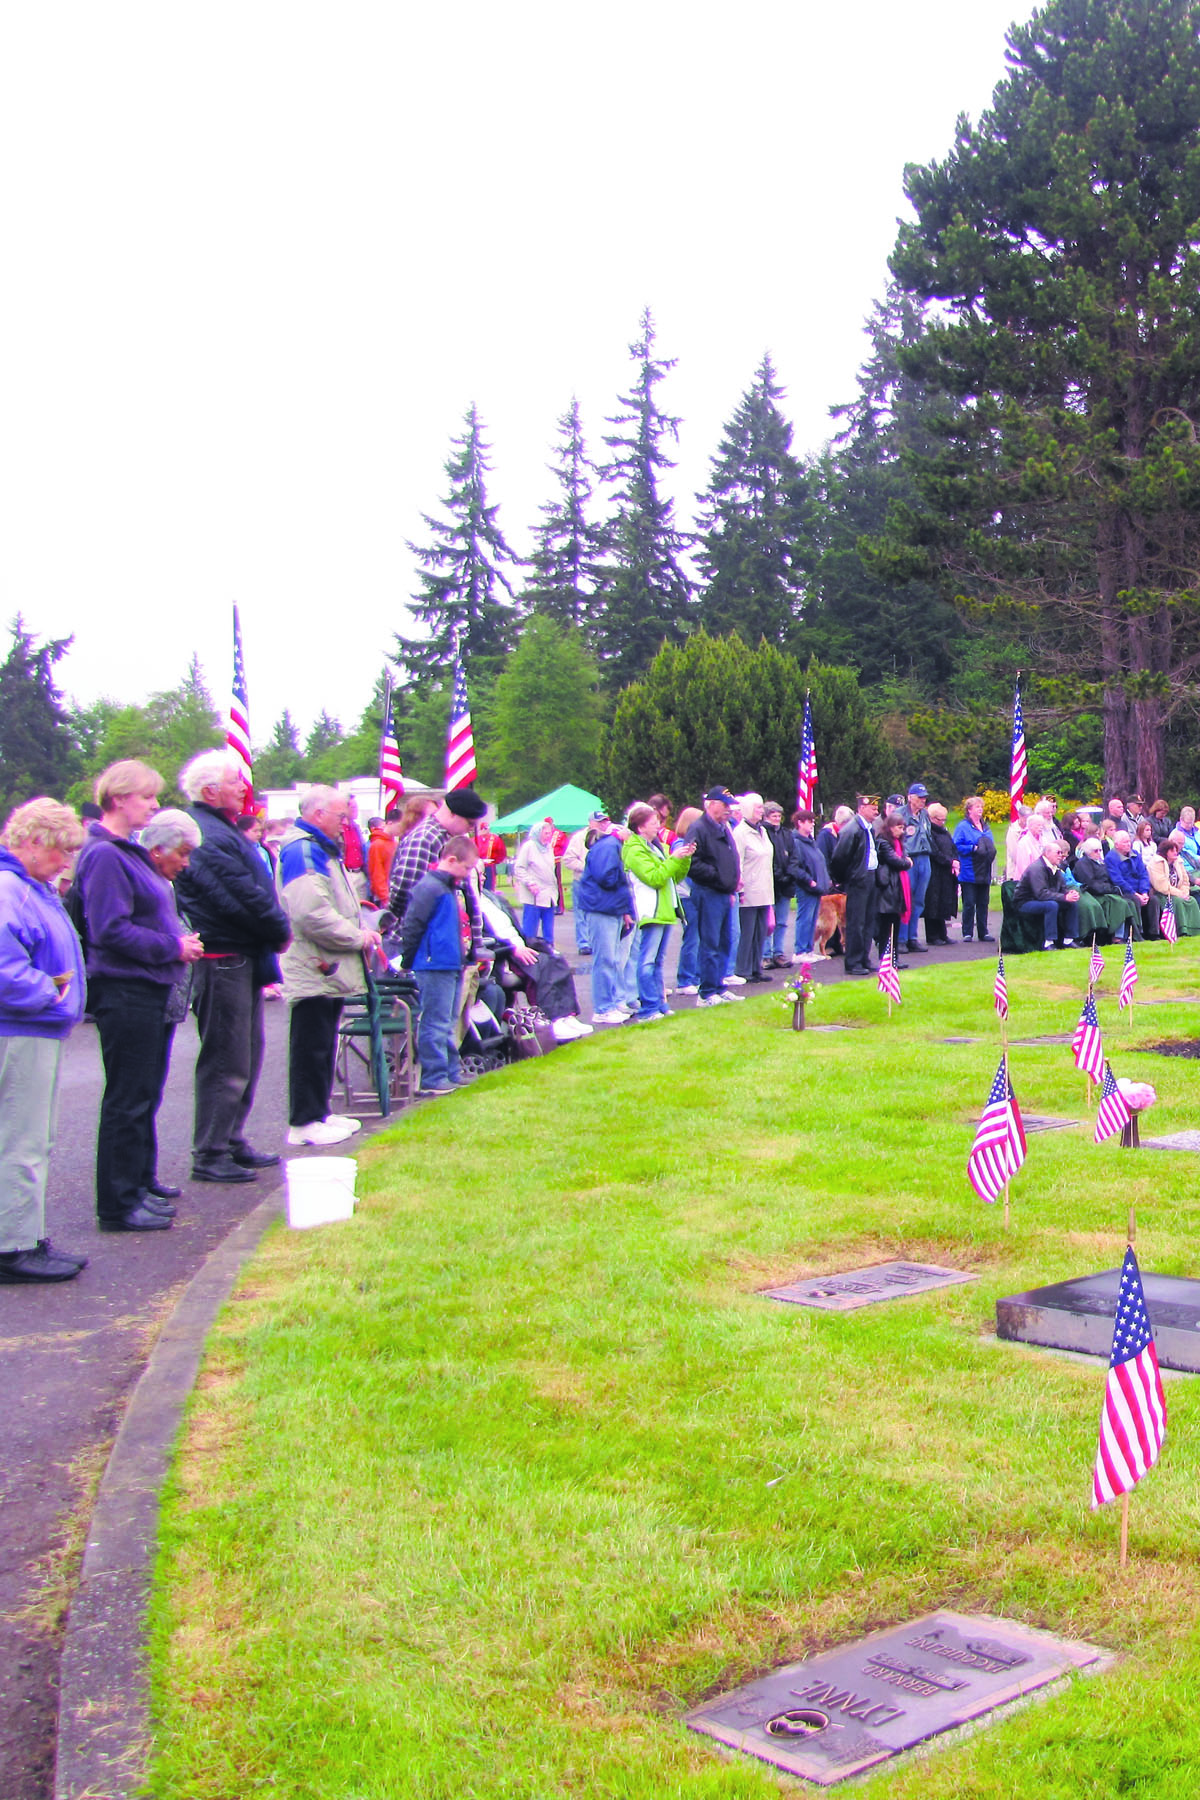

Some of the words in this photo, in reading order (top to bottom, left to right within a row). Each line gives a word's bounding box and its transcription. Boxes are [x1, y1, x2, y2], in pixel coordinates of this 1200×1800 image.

[905, 1636, 1009, 1674] JACQUELINE
[862, 1665, 939, 1697] BERNARD
[790, 1680, 906, 1727] LYNNE
